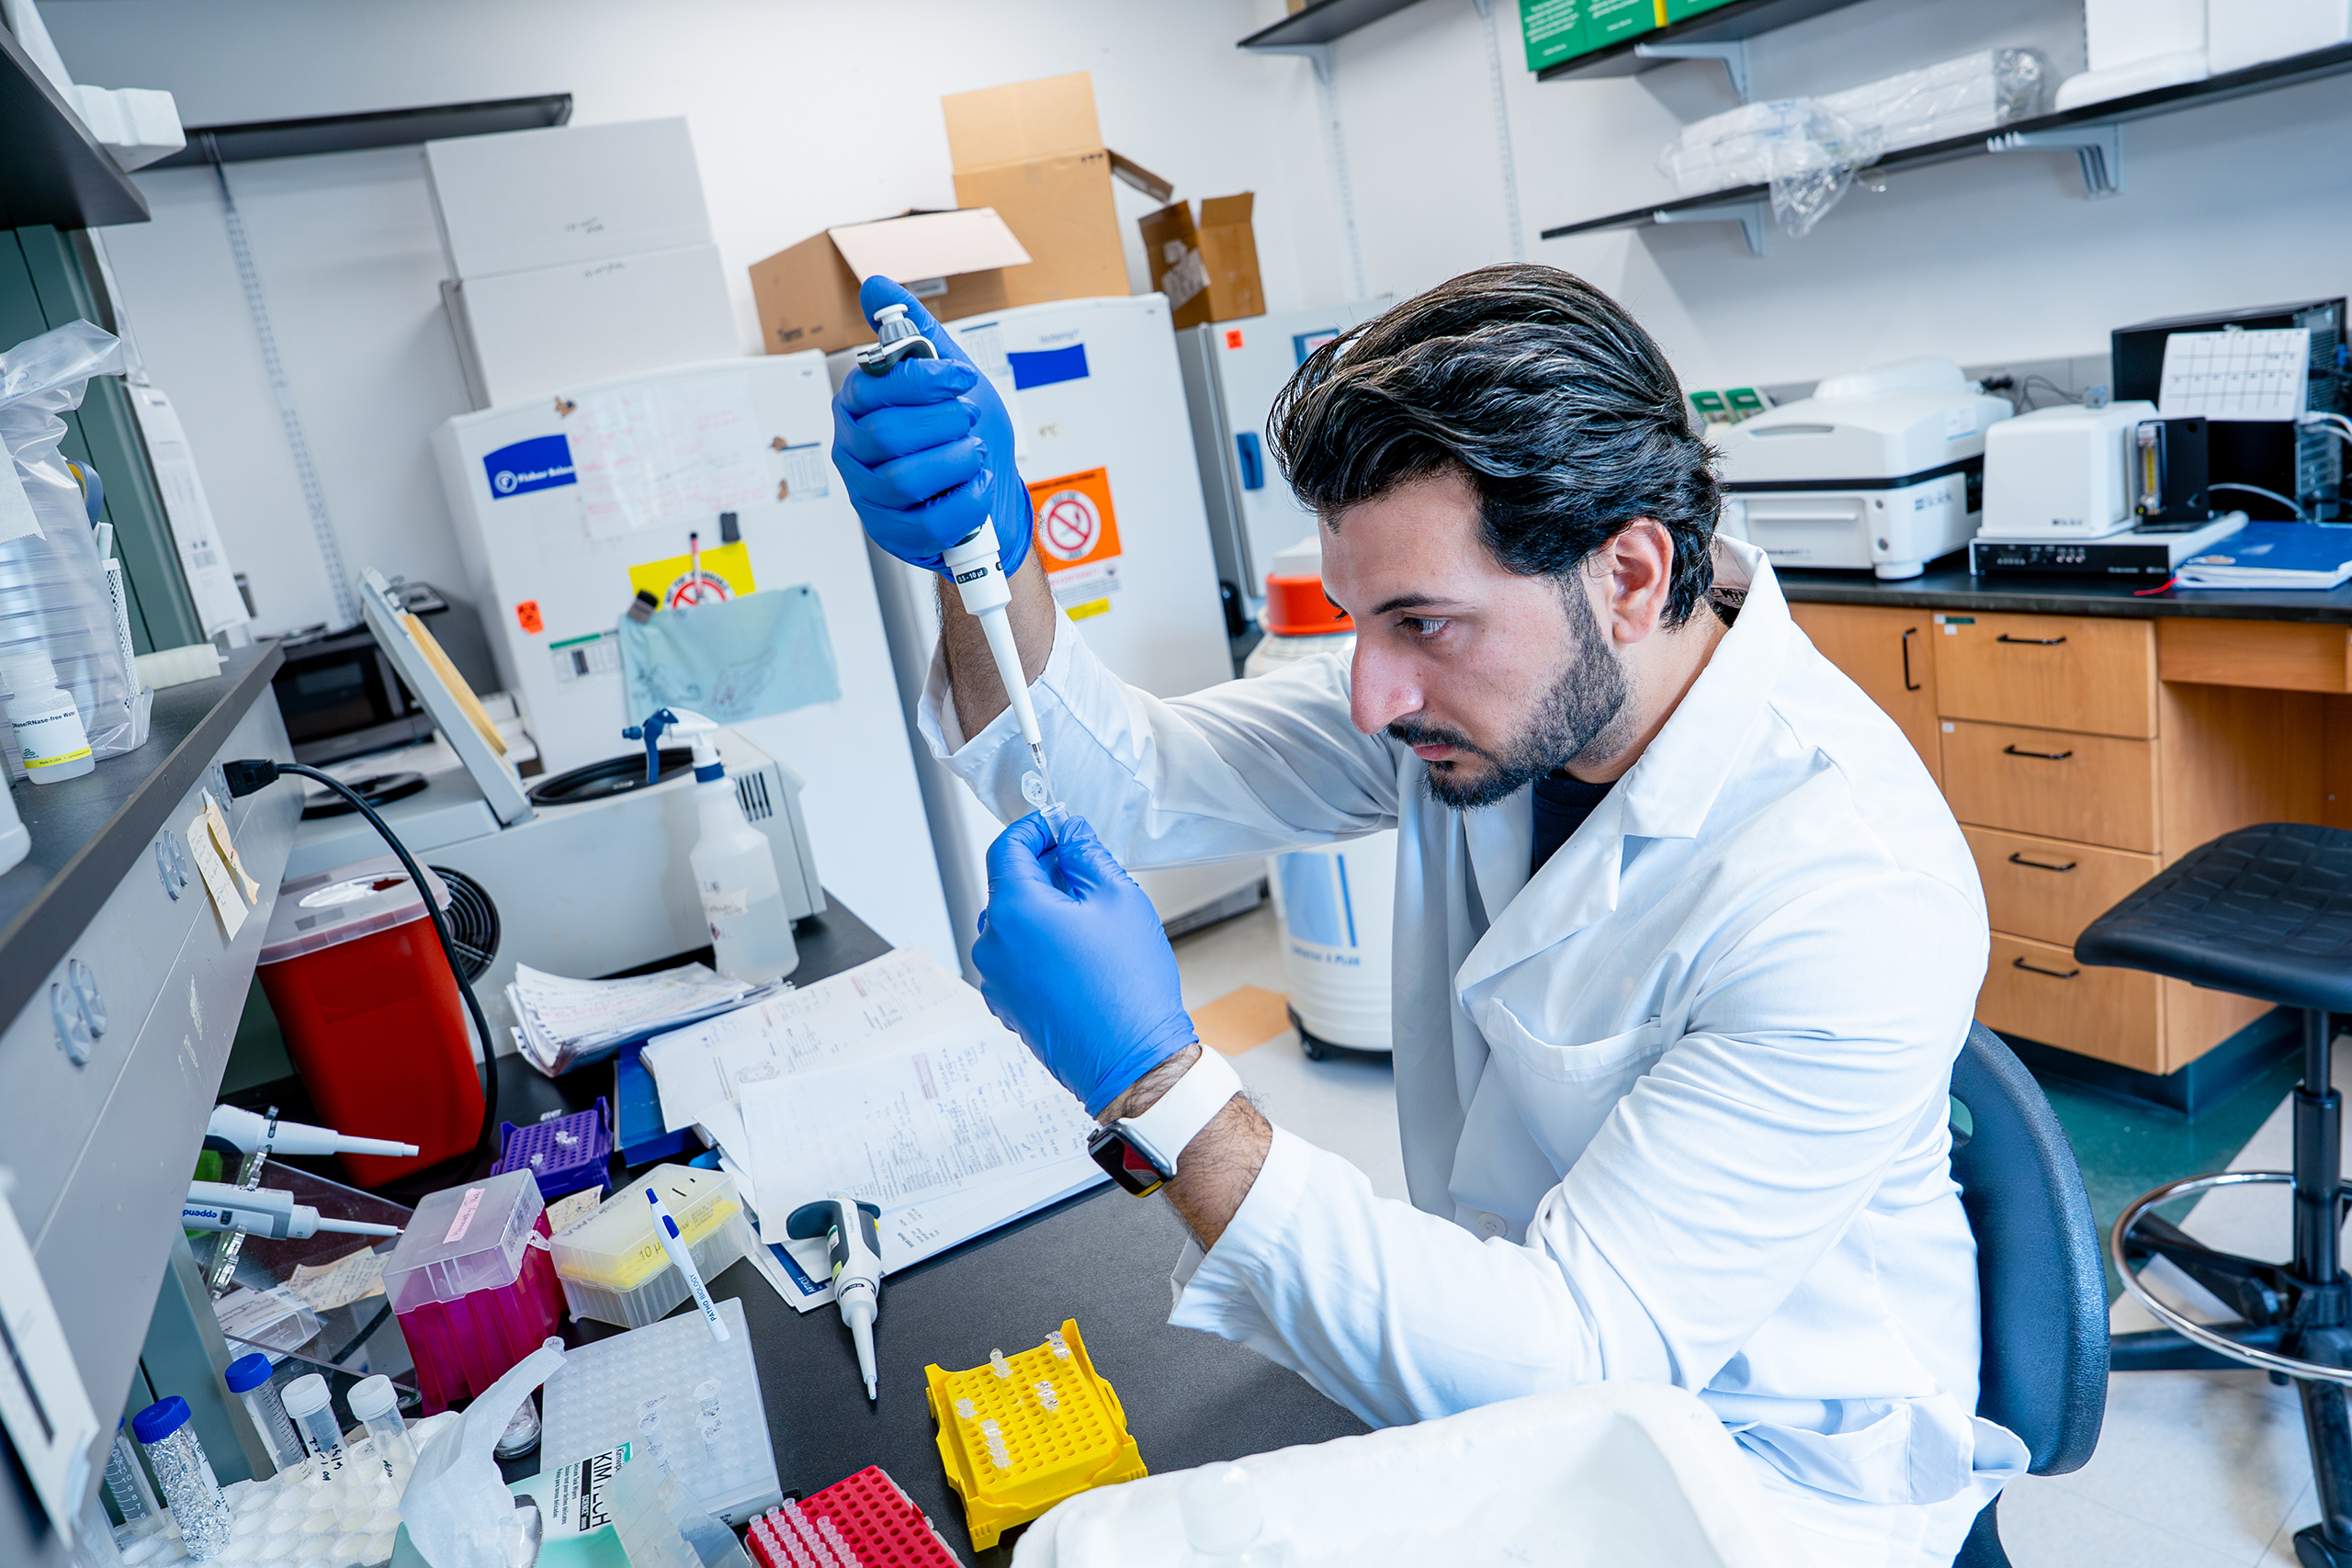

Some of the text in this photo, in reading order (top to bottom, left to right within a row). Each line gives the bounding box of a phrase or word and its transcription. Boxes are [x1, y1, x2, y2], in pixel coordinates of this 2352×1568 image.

[639, 1246, 652, 1261] 10
[797, 1275, 816, 1294] ARTICLE
[688, 1273, 717, 1322] PATHO BIOLOGY
[121, 1473, 133, 1483] 10
[127, 1484, 134, 1493] 9
